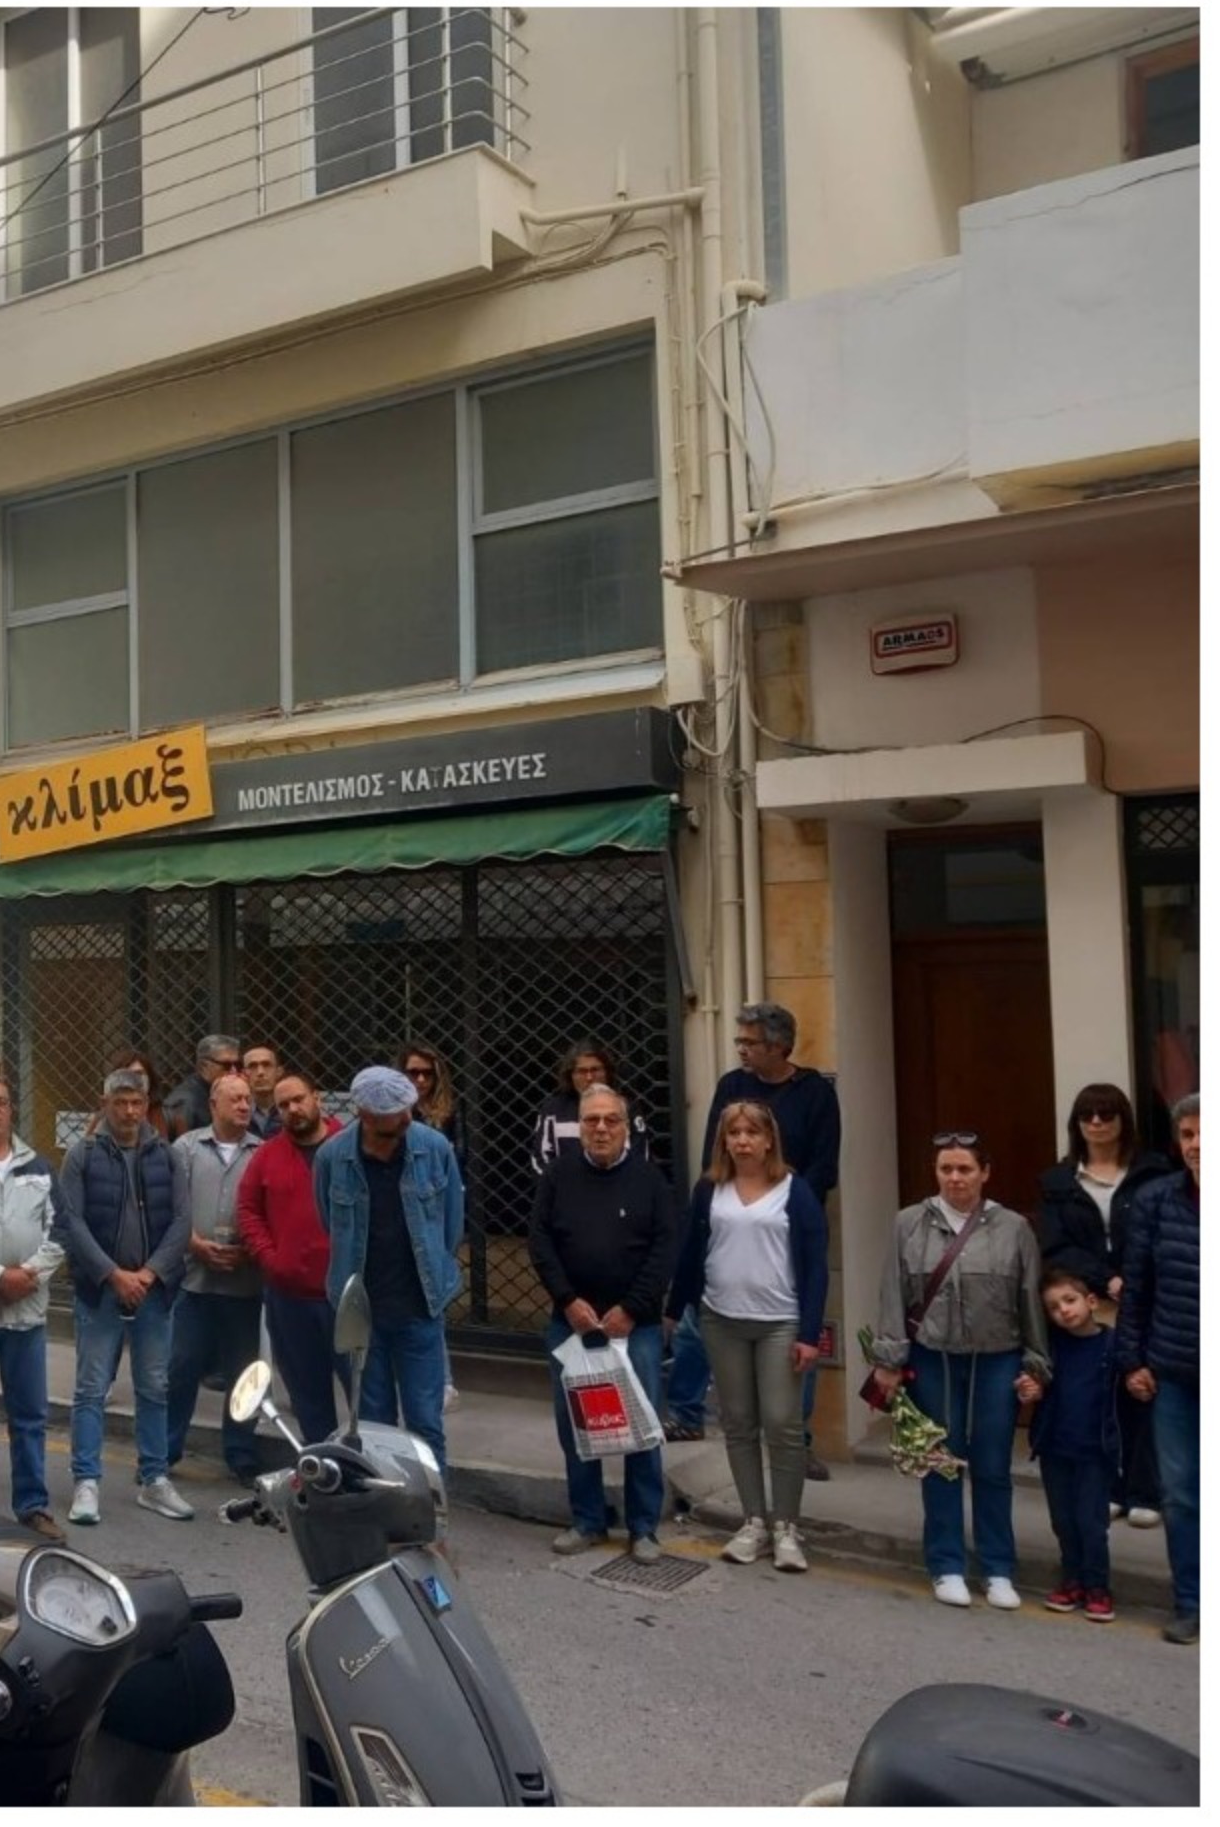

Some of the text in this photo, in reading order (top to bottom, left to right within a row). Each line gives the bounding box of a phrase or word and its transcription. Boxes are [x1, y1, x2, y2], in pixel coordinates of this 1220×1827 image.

[7, 744, 190, 836] κλίμαξ
[238, 773, 383, 811] ΜΟΝΤΕΛΙΣΜΟΣ
[401, 753, 547, 793] ΚΑΤΑΣΚΕΥΕΣ
